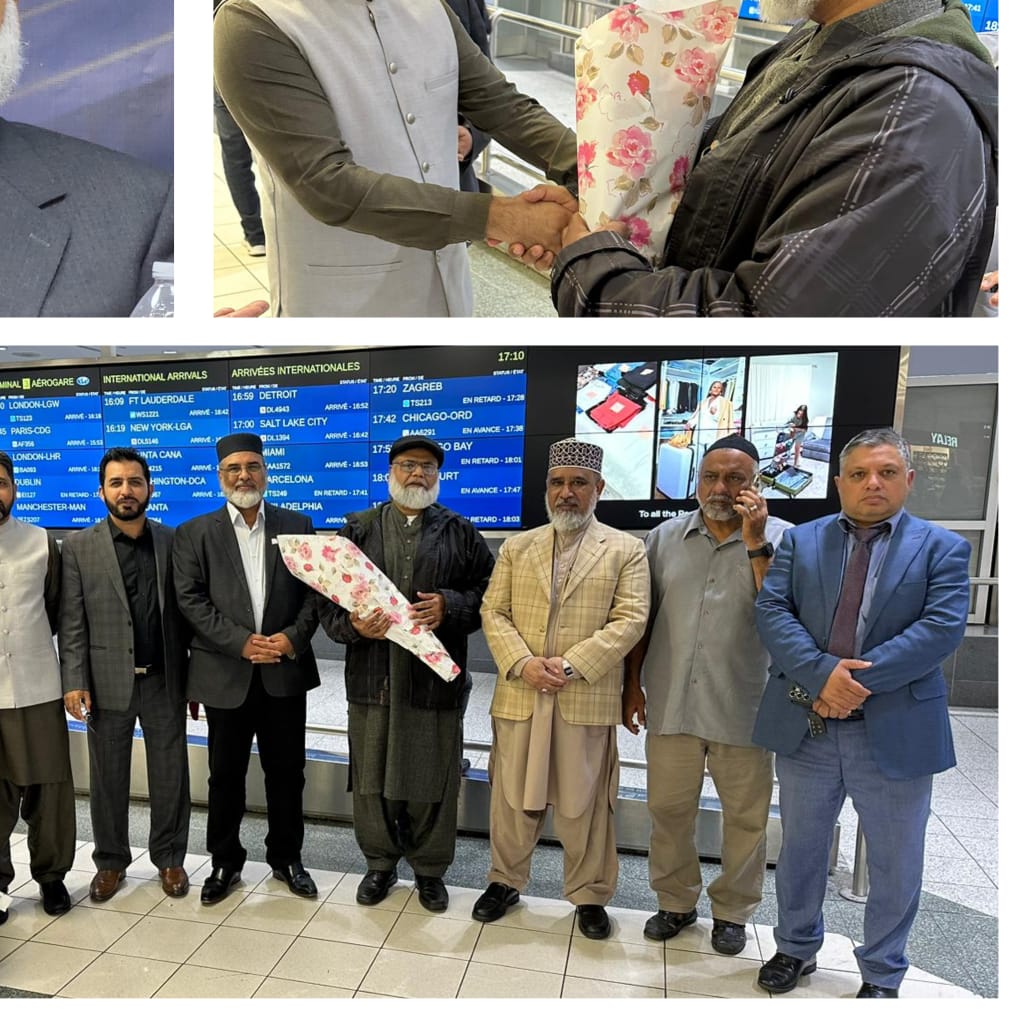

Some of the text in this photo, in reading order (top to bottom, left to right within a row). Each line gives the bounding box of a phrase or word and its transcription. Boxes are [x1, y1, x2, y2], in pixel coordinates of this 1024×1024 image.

[498, 351, 525, 362] 17:10
[231, 361, 361, 378] ARRIVÉES INTERNATIONALES
[32, 377, 74, 388] AÉROGARE
[103, 370, 208, 384] INTERNATIONAL ARRIVALS
[373, 382, 443, 394] 17:20 ZAGREB
[104, 394, 195, 406] 16:09 FT LAUDERDALE
[232, 390, 298, 401] 16:59 DETROIT
[463, 396, 473, 404] EN
[474, 396, 502, 404] RETARD
[9, 400, 60, 410] LONDON-LGW
[233, 417, 328, 429] 17:00 SALT LAKE CITY
[373, 411, 472, 424] 17:42 CHICAGO-ORD
[10, 426, 51, 435] PARIS-CDG
[105, 422, 192, 433] 16:19 NEW YORK-LGA
[473, 426, 500, 434] AVANCE
[453, 442, 474, 451] BAY
[12, 452, 61, 461] LONDON-LHR
[159, 451, 183, 459] CANA
[16, 503, 86, 512] MANCHESTER-MAN
[638, 510, 649, 518] To
